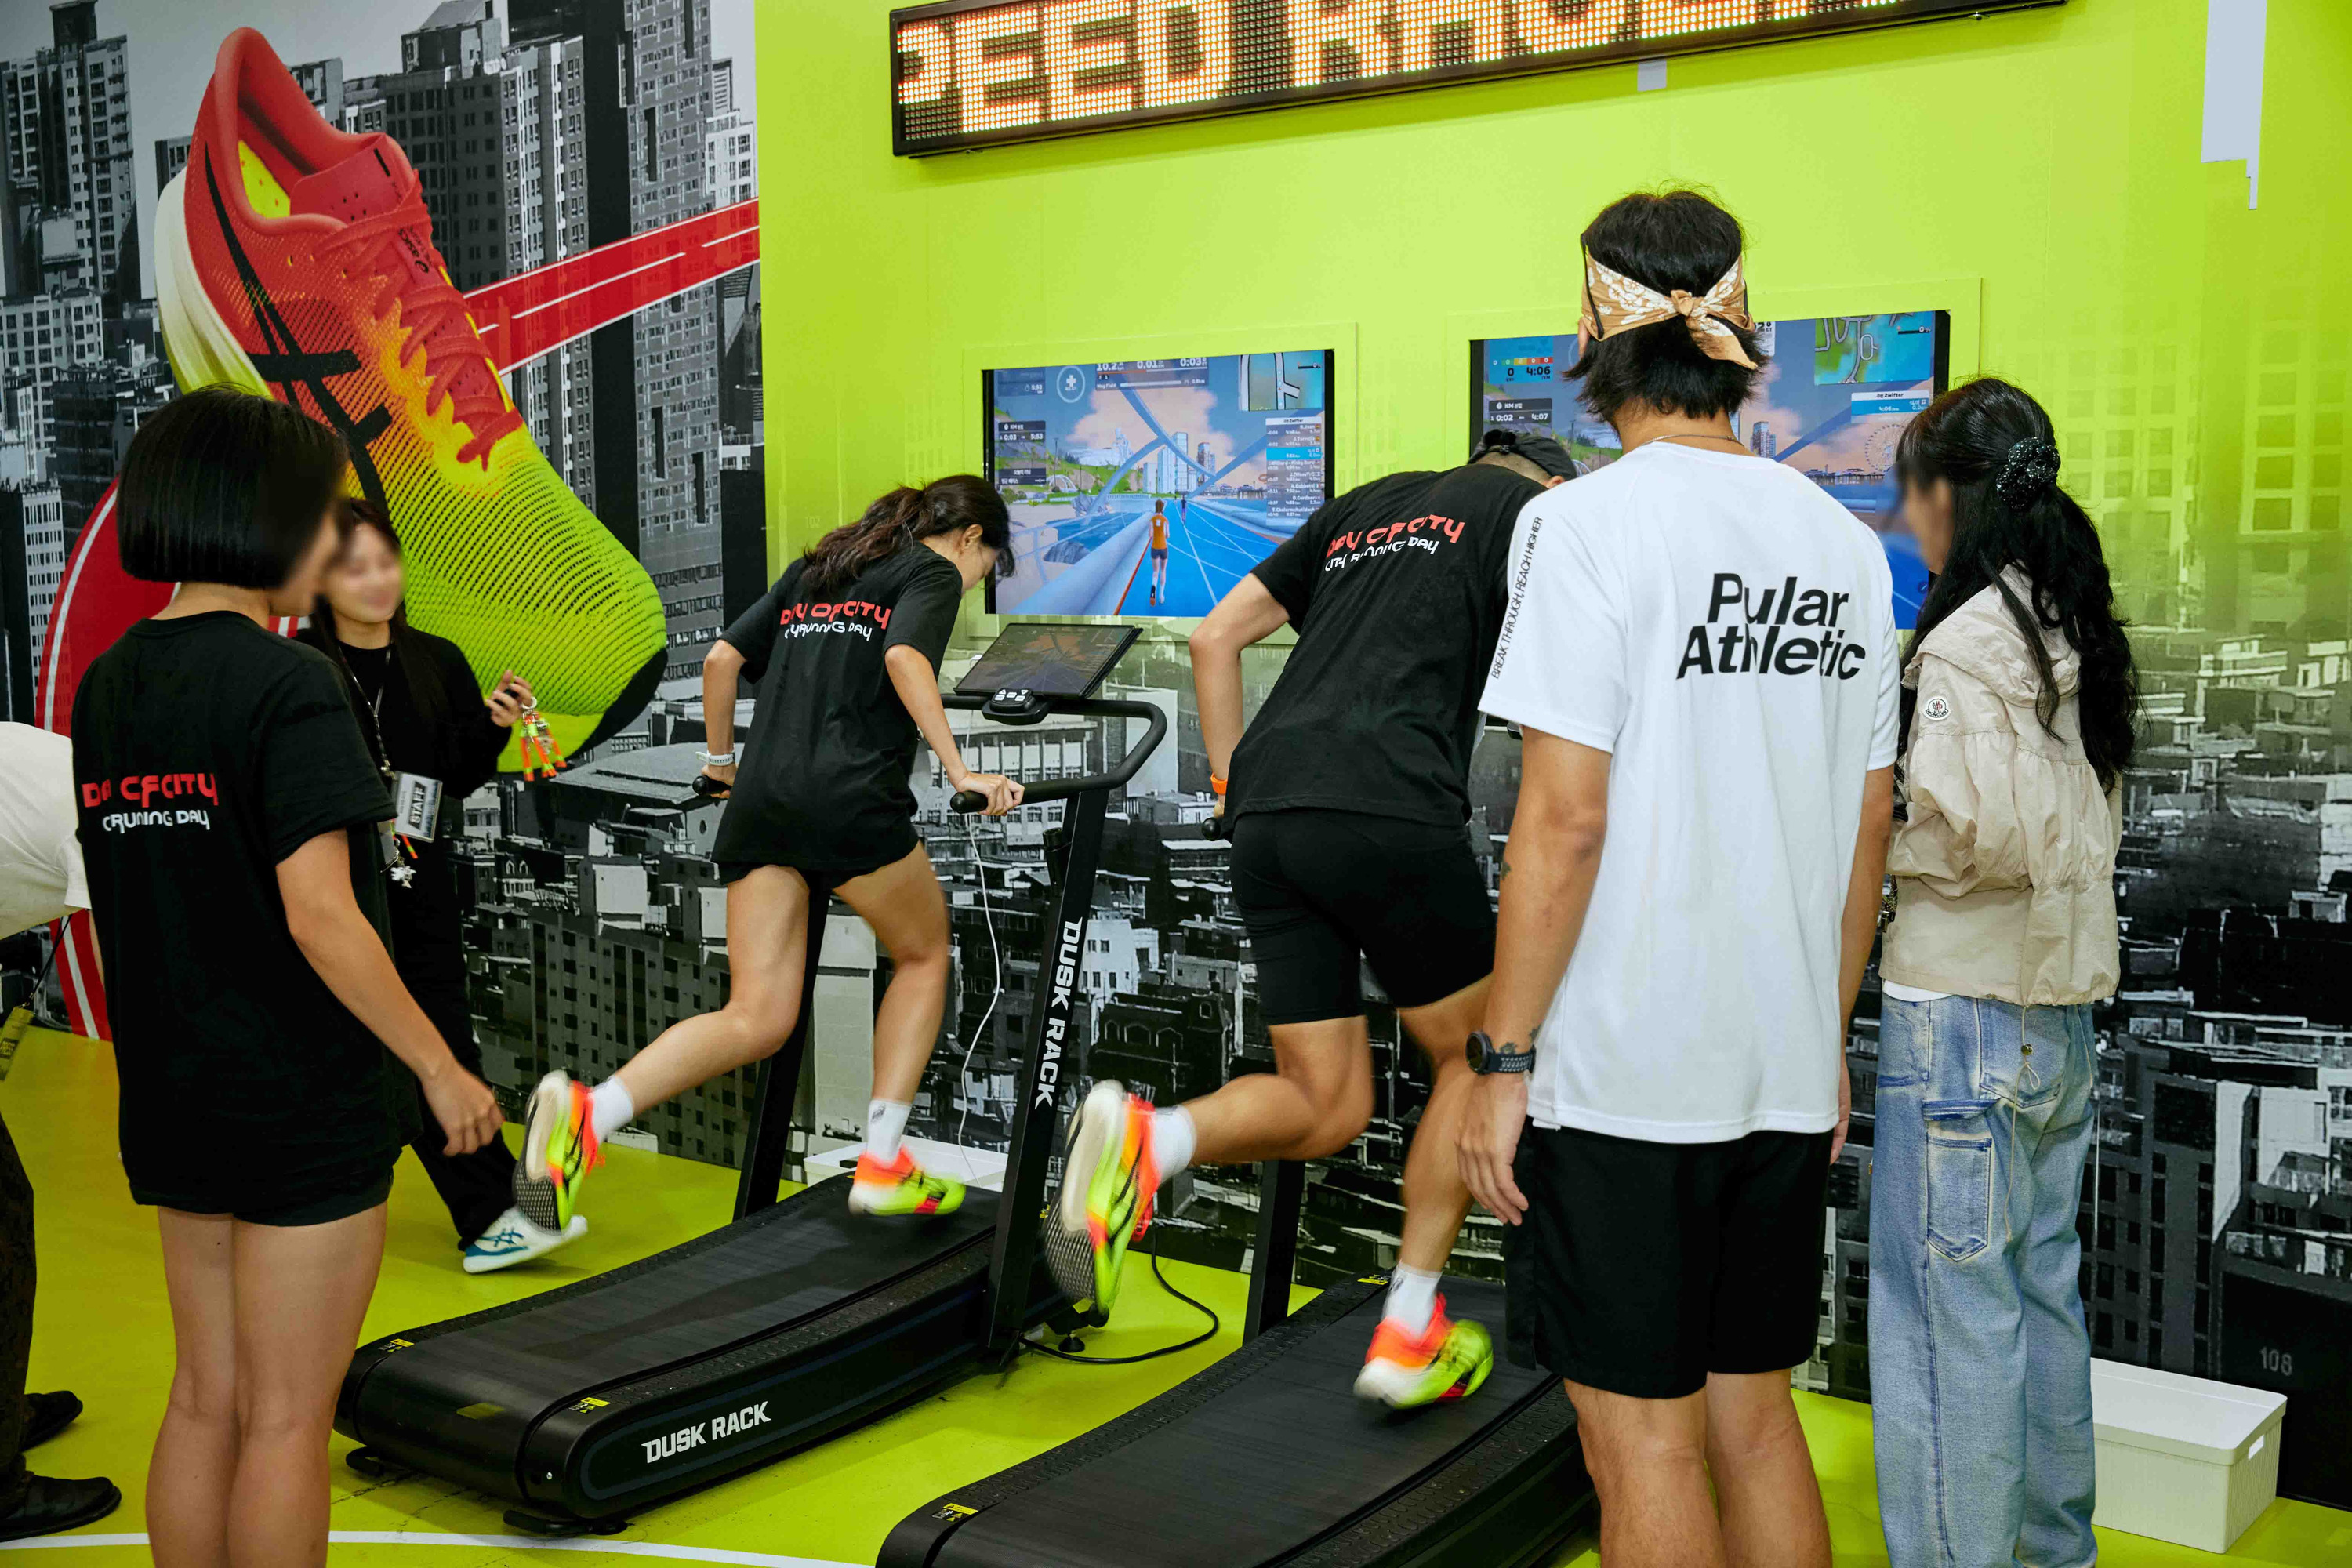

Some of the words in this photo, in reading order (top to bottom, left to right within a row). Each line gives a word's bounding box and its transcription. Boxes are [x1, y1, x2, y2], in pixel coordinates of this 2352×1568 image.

[1508, 368, 1514, 376] 0
[1526, 366, 1551, 376] 4:06
[1407, 536, 1440, 555] DAY
[843, 601, 891, 630] CITY
[1491, 644, 1509, 680] BREAK
[1501, 593, 1526, 644] THROUGH,
[1515, 554, 1533, 592] REACH
[1525, 516, 1543, 555] HIGHER
[1707, 573, 1849, 627] Pular
[848, 622, 873, 642] DAY
[1675, 623, 1866, 680] Athletic
[161, 773, 219, 806] CITY
[408, 786, 426, 826] STAFF
[176, 809, 210, 831] DAY
[1051, 916, 1083, 1011] DUSK
[1034, 1017, 1067, 1110] RACK
[2259, 1346, 2293, 1377] 108
[641, 1421, 706, 1465] DUSK
[711, 1400, 772, 1441] RACK
